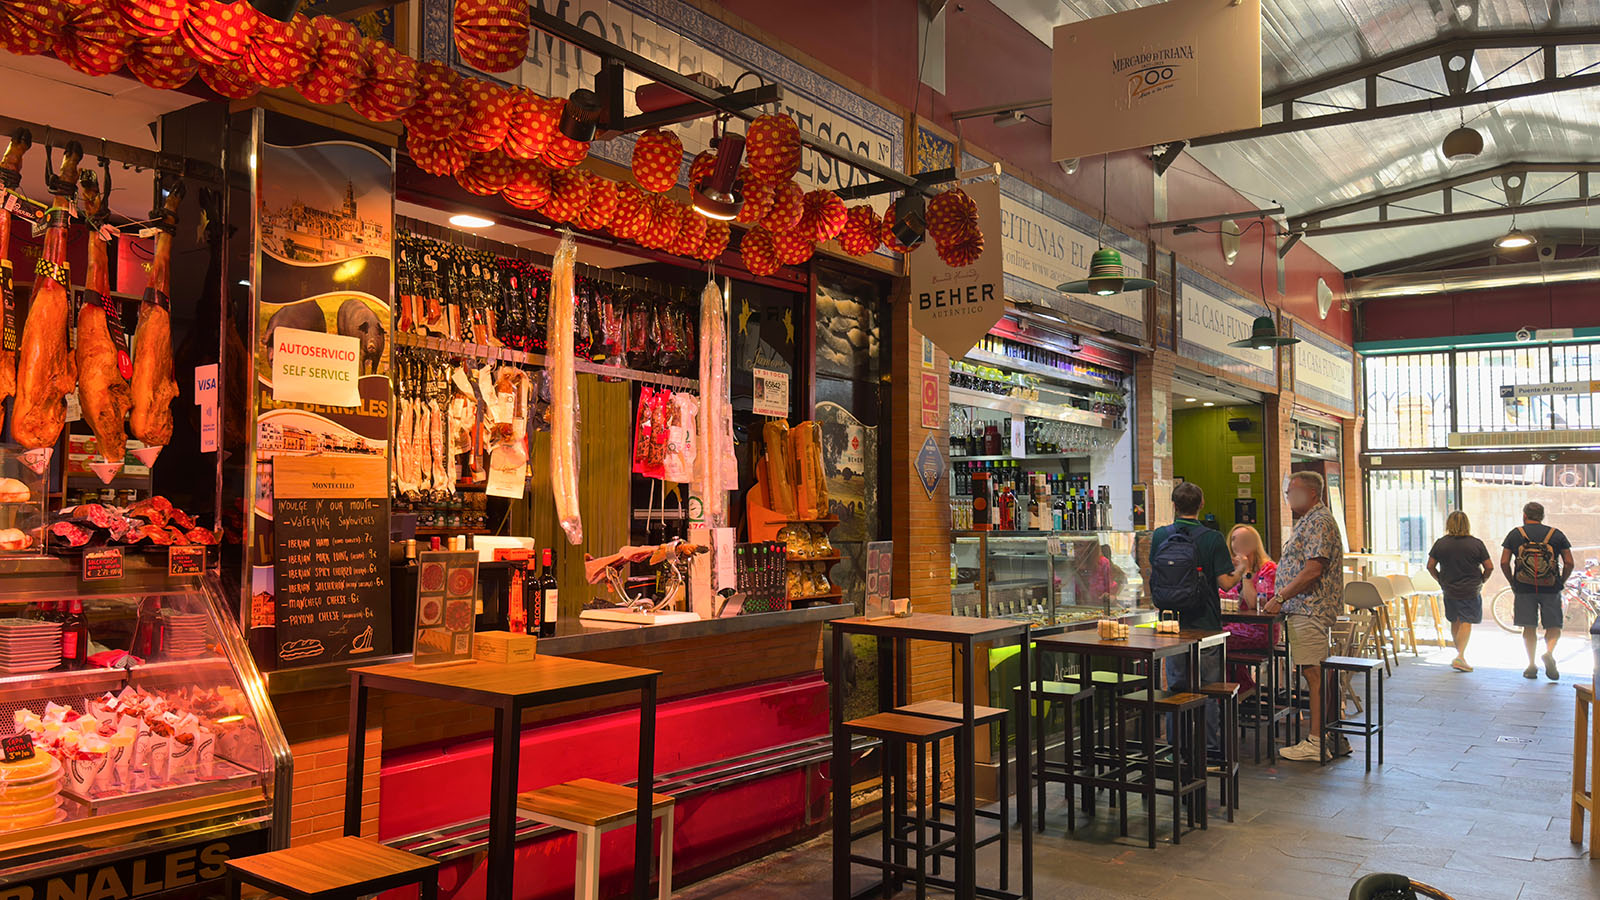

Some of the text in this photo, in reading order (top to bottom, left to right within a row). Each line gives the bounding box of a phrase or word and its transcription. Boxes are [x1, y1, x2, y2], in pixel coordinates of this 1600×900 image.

[1112, 52, 1152, 75] MERCADO
[1159, 45, 1194, 61] TRIANA
[1127, 67, 1174, 97] 200
[1071, 241, 1088, 271] EL
[919, 283, 995, 310] BEHER
[1188, 297, 1201, 325] LA
[1202, 304, 1226, 336] CASA
[279, 342, 356, 362] AUTOSERVICIO
[282, 364, 350, 382] SELF SERVICE
[198, 377, 217, 391] VISA
[316, 499, 325, 514] IN
[329, 501, 345, 515] OUR
[288, 538, 311, 550] IBERIAN
[288, 552, 312, 566] IBERIAN
[288, 567, 311, 580] IBERIAN
[288, 582, 311, 594] IBERIAN
[327, 595, 347, 606] CHEESE
